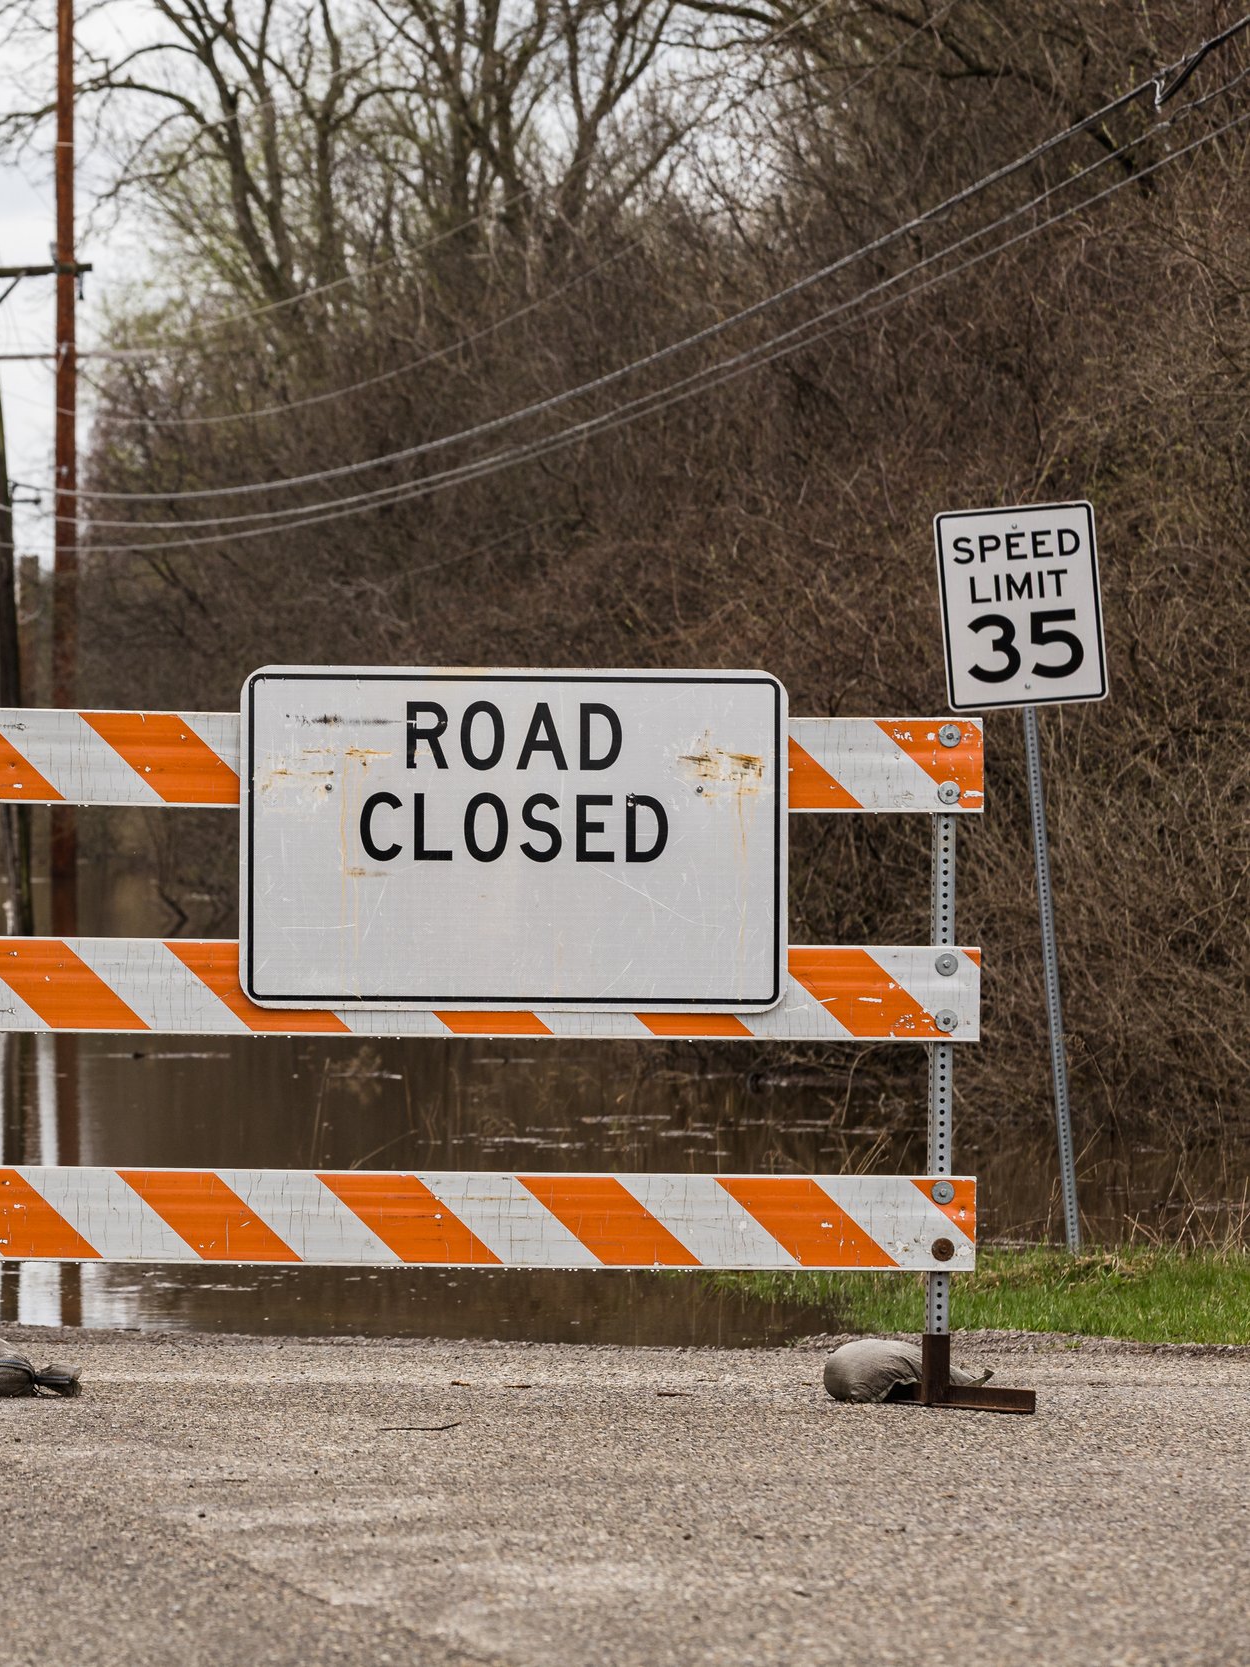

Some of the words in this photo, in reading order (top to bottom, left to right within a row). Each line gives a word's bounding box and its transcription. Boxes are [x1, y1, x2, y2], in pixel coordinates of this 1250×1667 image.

[952, 528, 1081, 565] SPEED
[969, 568, 1068, 604] LIMIT
[967, 608, 1085, 684] 35
[406, 700, 623, 771] ROAD
[359, 791, 669, 863] CLOSED
